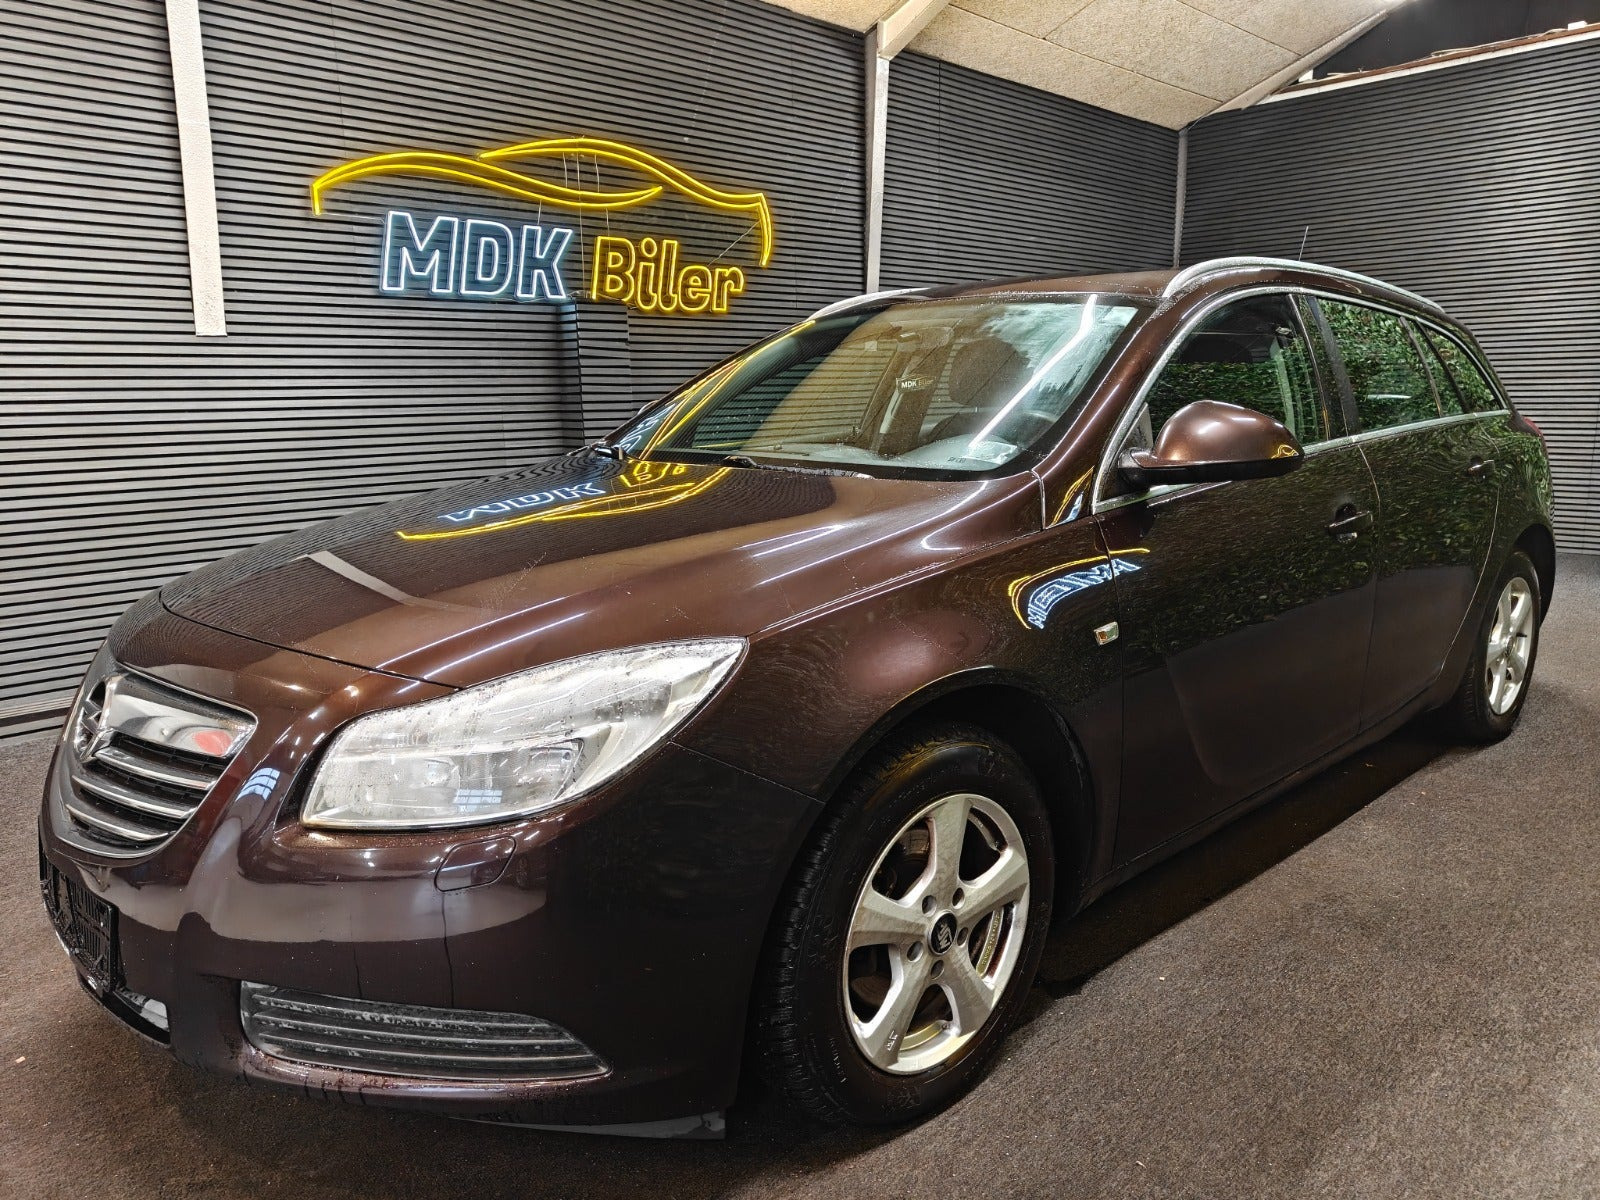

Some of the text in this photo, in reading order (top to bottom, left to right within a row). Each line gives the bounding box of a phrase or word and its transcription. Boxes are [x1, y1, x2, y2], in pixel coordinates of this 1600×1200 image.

[381, 211, 746, 313] MDK Biler
[901, 380, 917, 388] MDK
